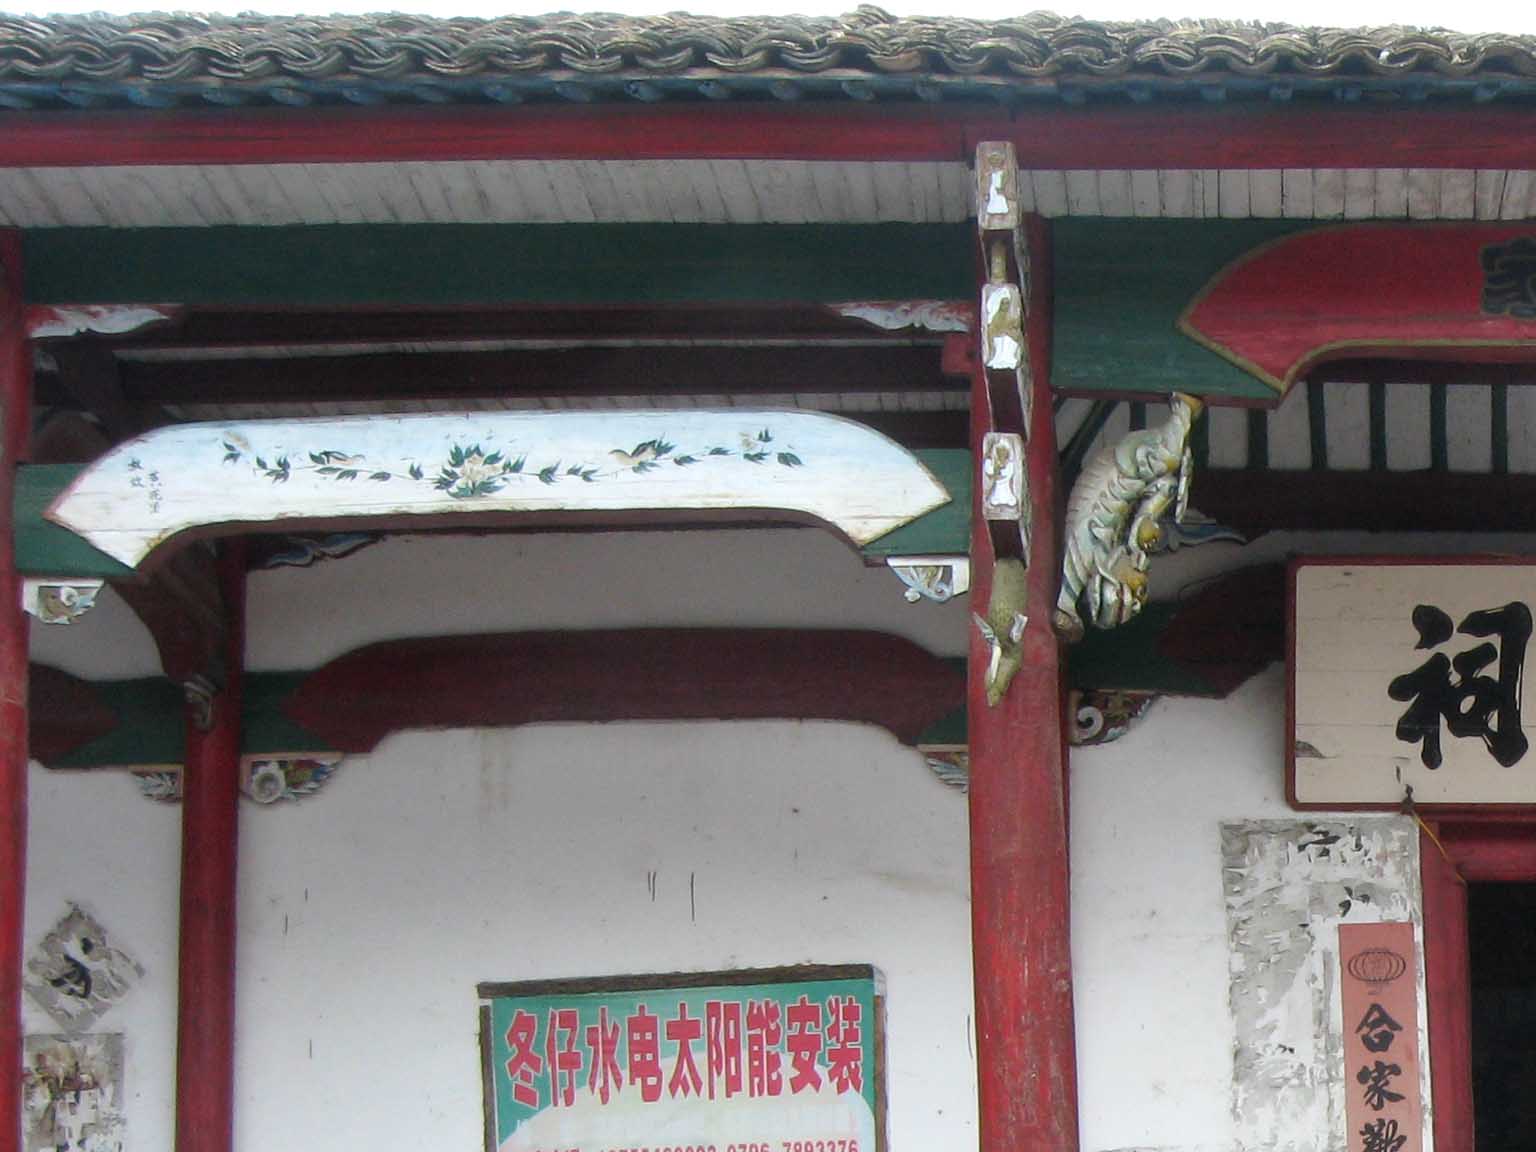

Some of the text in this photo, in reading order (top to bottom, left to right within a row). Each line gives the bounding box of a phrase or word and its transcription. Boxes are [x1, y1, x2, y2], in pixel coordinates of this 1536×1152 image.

[505, 996, 864, 1108] 冬仔水电太阳能安装
